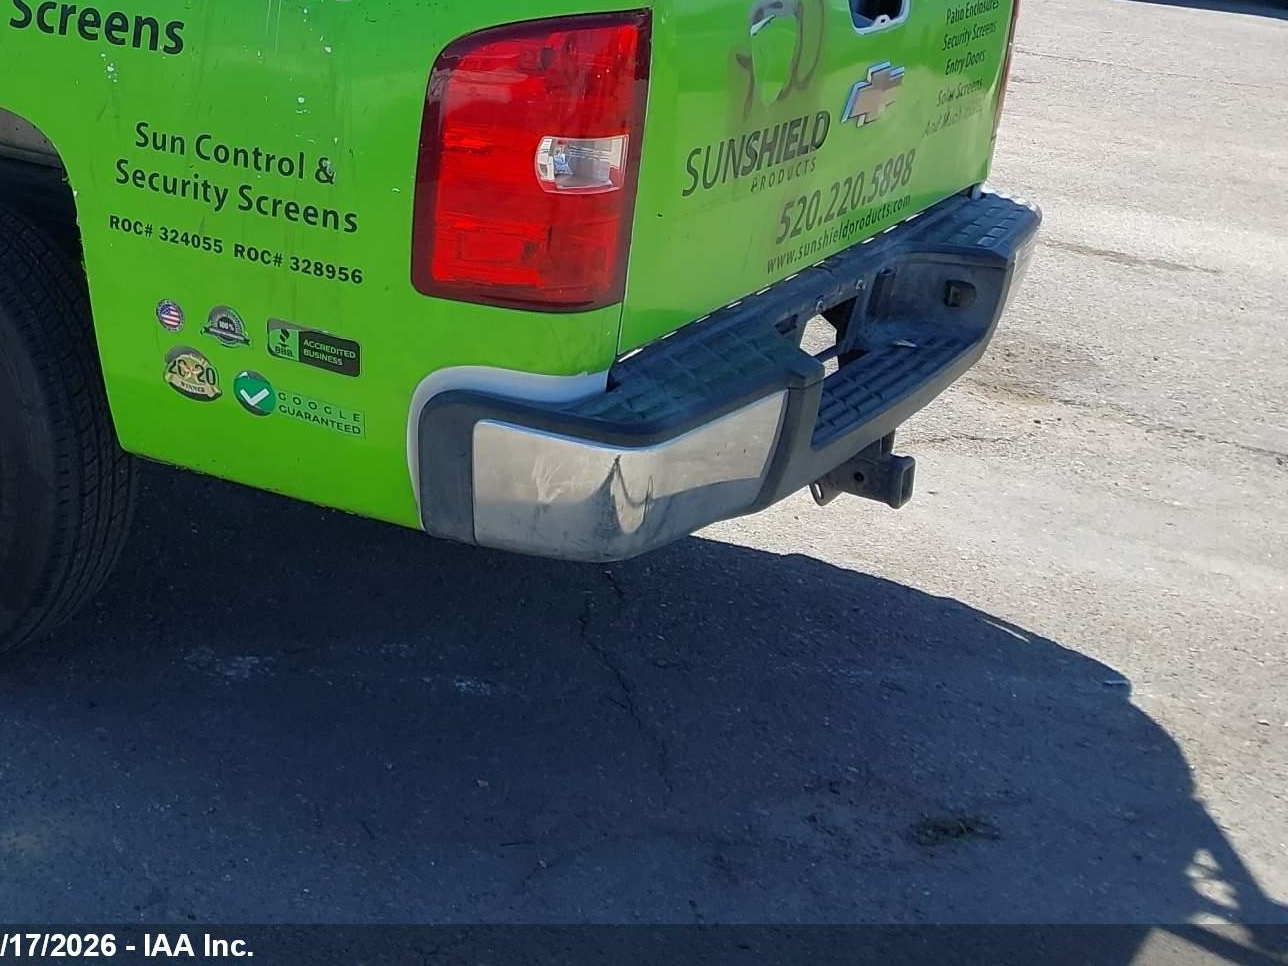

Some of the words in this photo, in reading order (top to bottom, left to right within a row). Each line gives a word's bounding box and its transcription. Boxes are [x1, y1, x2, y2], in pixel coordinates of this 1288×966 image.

[946, 5, 963, 25] Patio
[942, 27, 972, 52] Security
[972, 20, 997, 41] Screens
[945, 56, 964, 76] Entry
[965, 49, 985, 68] Doors
[135, 121, 186, 155] Sun
[195, 134, 305, 179] Control
[314, 156, 336, 185] &
[682, 109, 831, 197] SUNSHIELD
[750, 156, 817, 193] PRODUCTS
[115, 159, 229, 212] Security
[238, 184, 358, 233] Screens
[775, 148, 916, 245] 520.220.5898
[109, 215, 153, 238] ROC#
[159, 227, 223, 254] 324055
[234, 243, 284, 268] ROC#
[289, 256, 364, 284] 328956
[767, 194, 912, 274] www.sunshieldproducts.com
[303, 339, 357, 359] ACCREDITED
[303, 348, 343, 367] BUSINESS
[278, 391, 360, 423] GOOGLE
[279, 404, 361, 436] GUARANTEED
